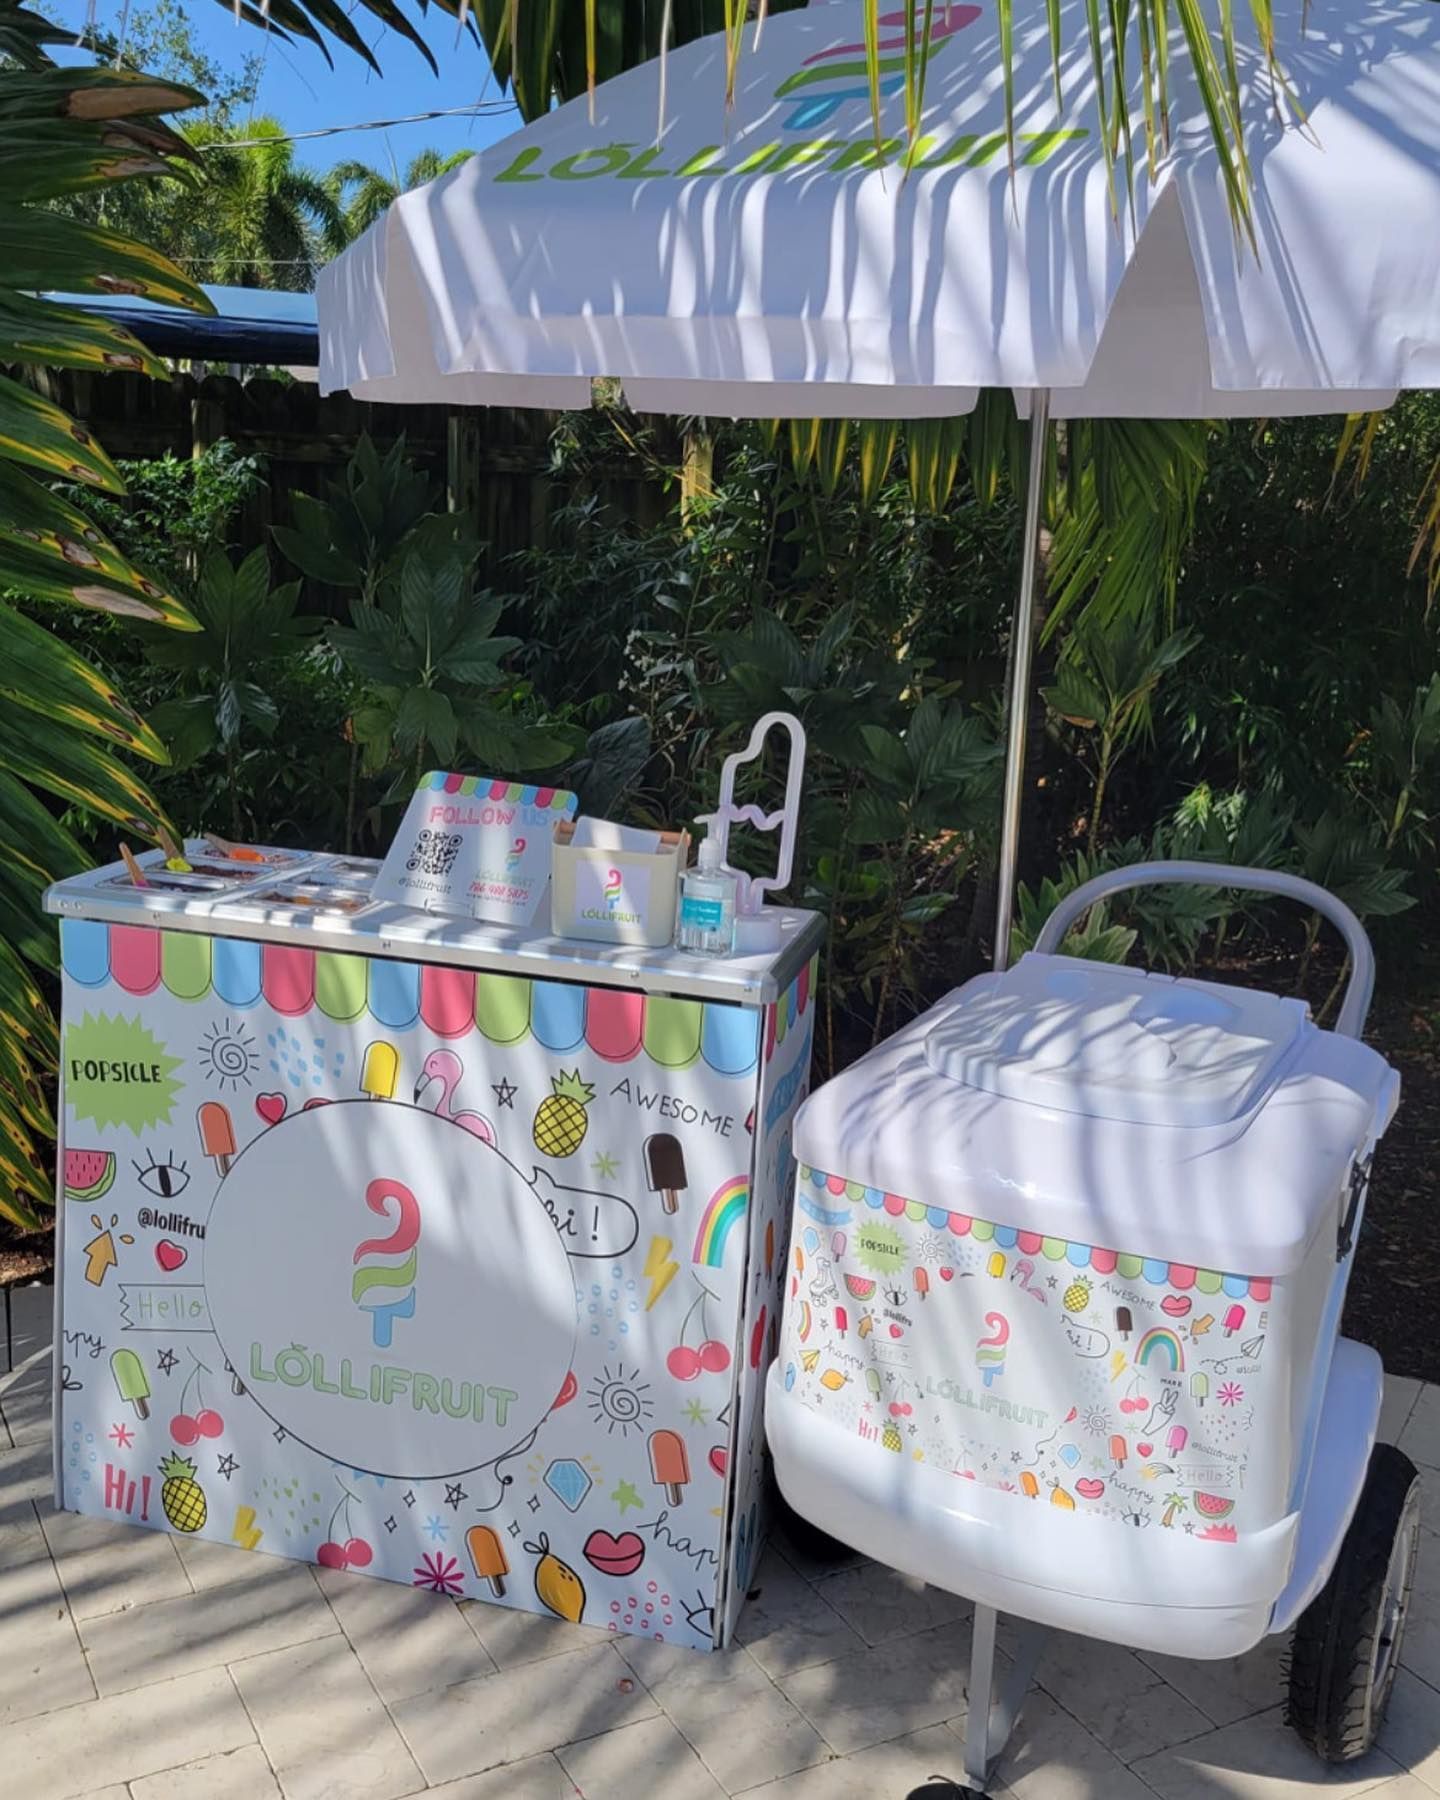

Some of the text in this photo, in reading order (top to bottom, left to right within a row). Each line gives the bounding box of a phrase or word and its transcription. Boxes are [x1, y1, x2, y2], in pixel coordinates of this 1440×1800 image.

[430, 805, 549, 826] FOLLOW US
[72, 1059, 162, 1083] POPSICLE
[610, 1077, 734, 1138] AWESOME
[138, 1292, 203, 1320] Hello
[1100, 1280, 1155, 1312] AWESOME
[858, 1417, 879, 1443] Hi!
[104, 1463, 152, 1522] Hi!
